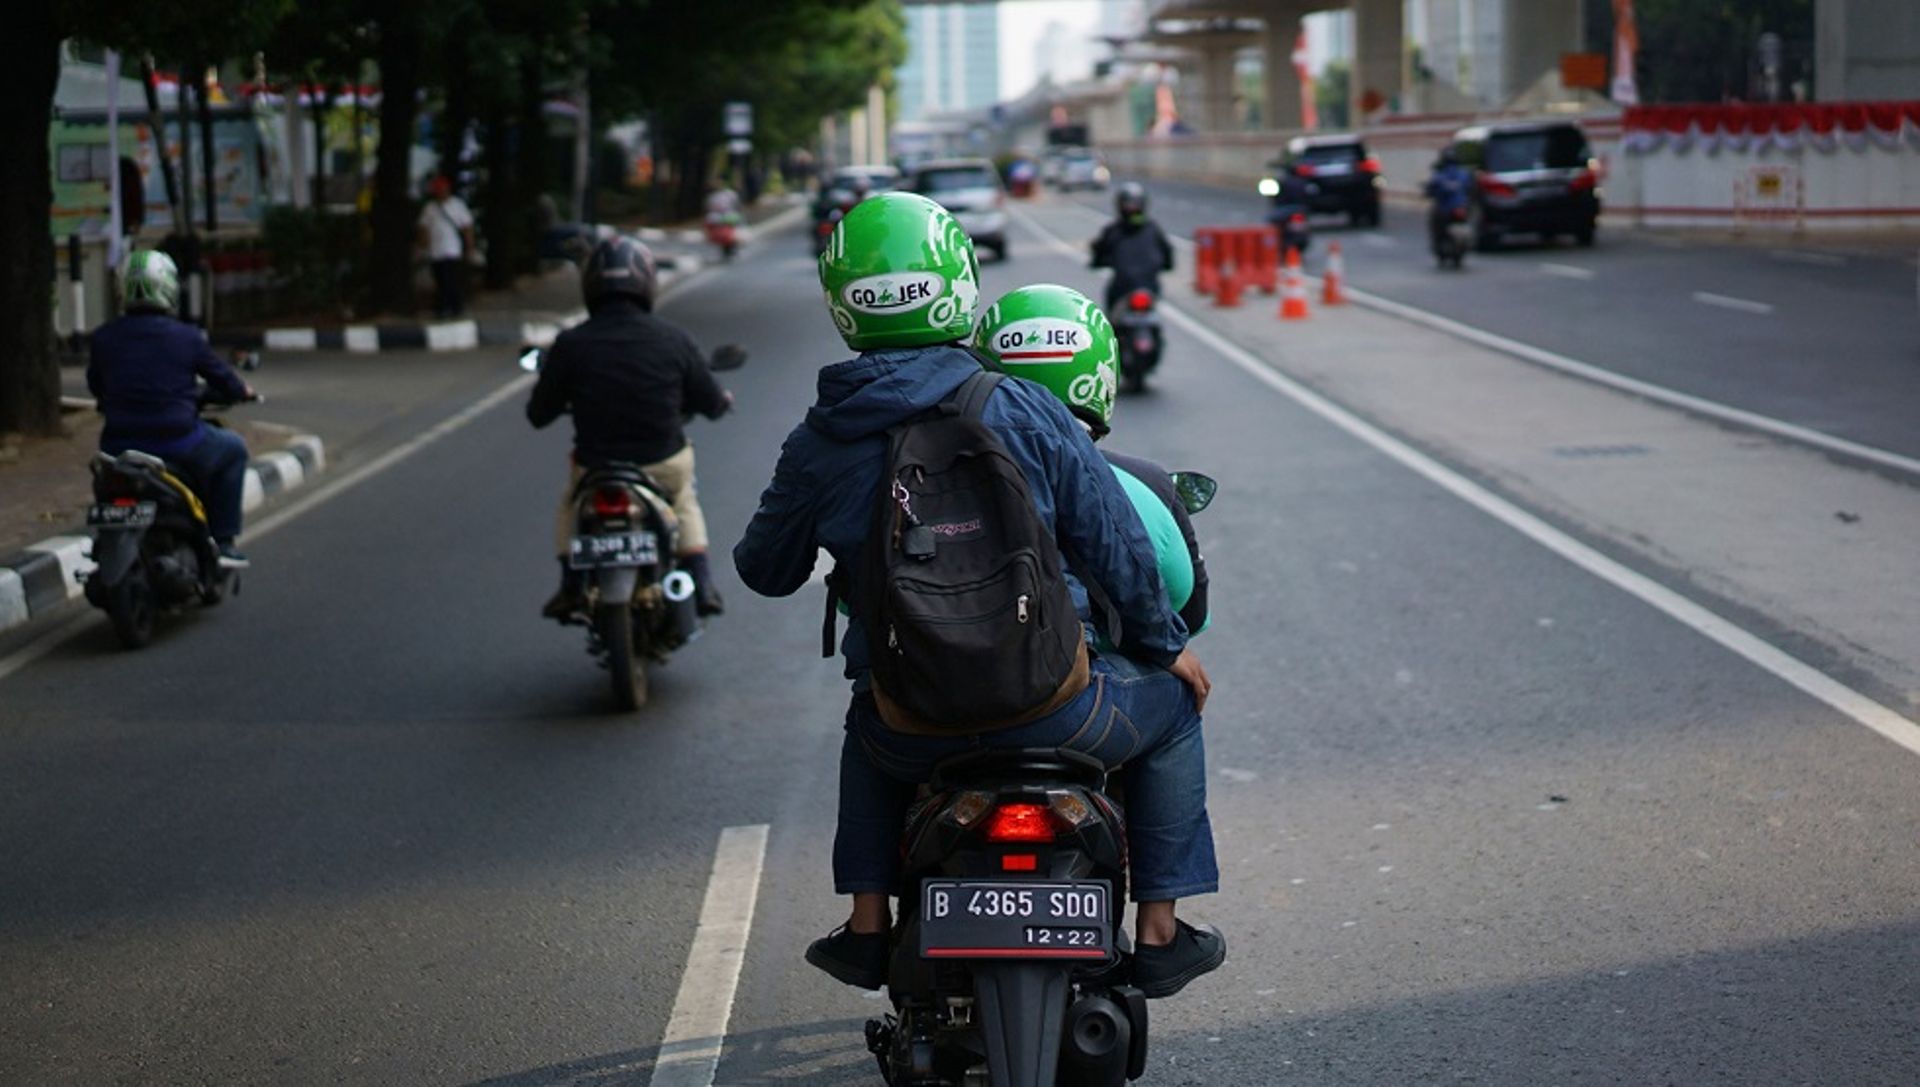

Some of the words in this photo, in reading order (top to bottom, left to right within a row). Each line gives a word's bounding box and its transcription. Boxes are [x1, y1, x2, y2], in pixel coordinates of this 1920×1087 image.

[851, 287, 876, 305] GO
[899, 280, 931, 303] JEK
[999, 330, 1024, 348] GO
[1045, 329, 1078, 346] JEK
[934, 891, 949, 917] B
[967, 890, 1033, 916] 4365
